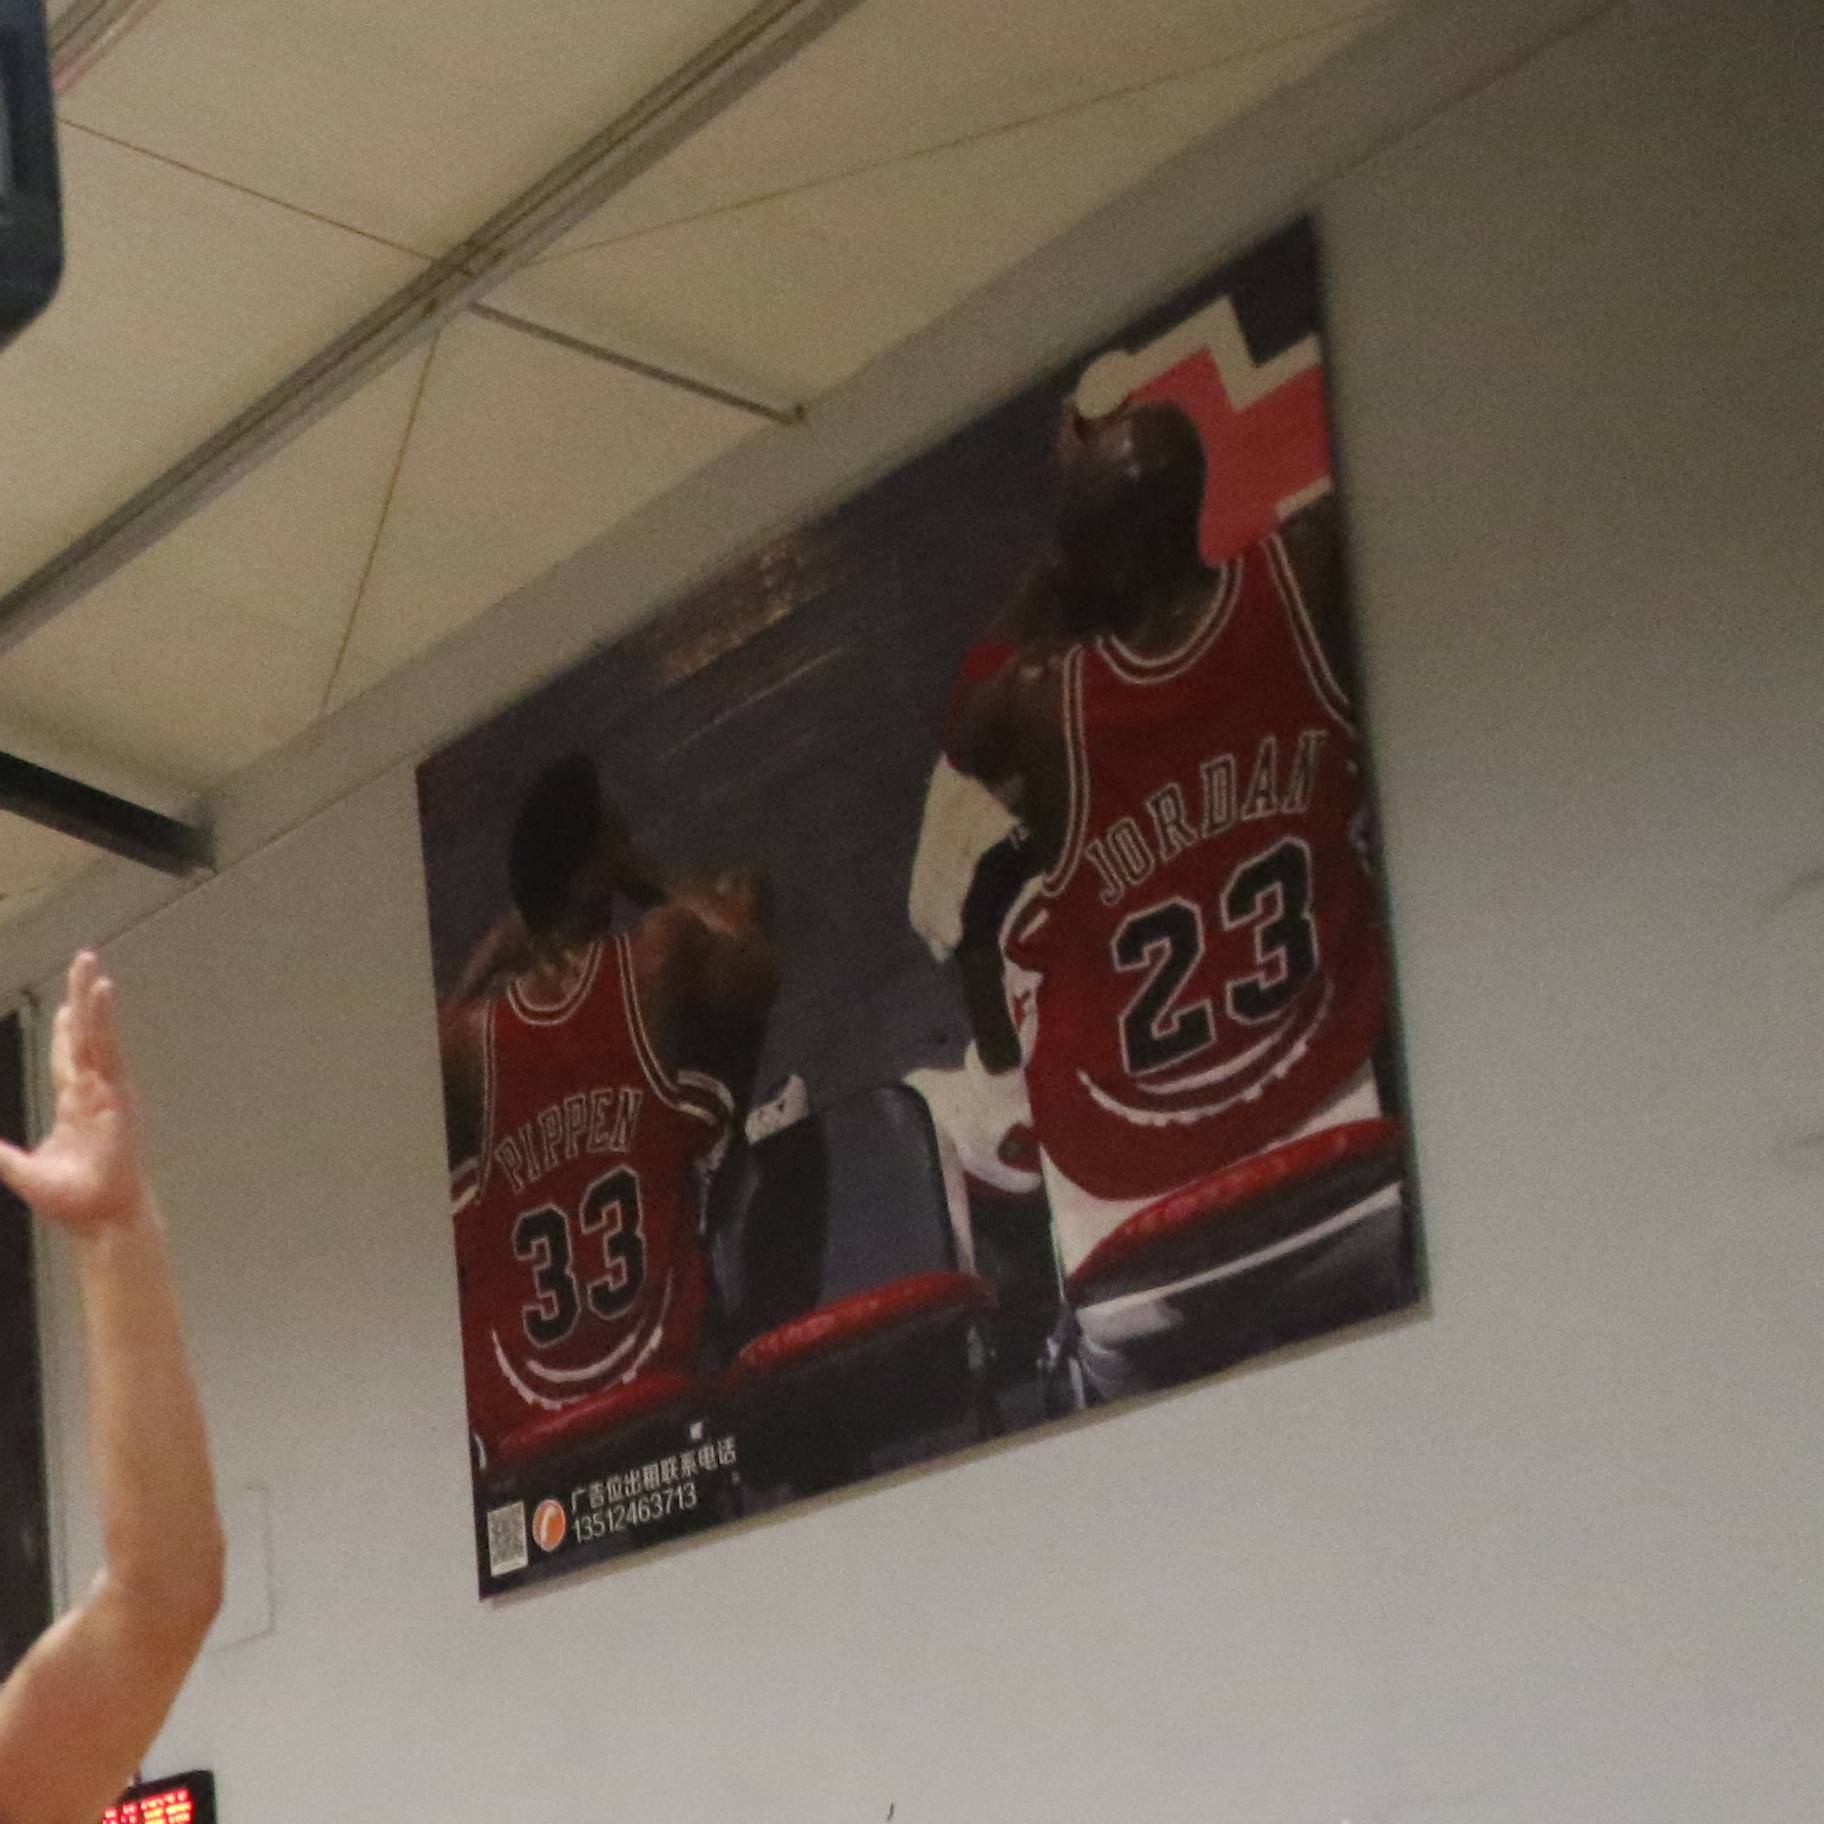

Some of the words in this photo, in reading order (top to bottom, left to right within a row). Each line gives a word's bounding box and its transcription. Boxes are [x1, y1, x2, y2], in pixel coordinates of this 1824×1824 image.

[1084, 728, 1329, 905] JORDAN
[1109, 836, 1322, 1077] 23
[493, 1086, 644, 1195] PIPPEN
[511, 1163, 647, 1349] 33
[572, 1482, 698, 1543] 13512463713
